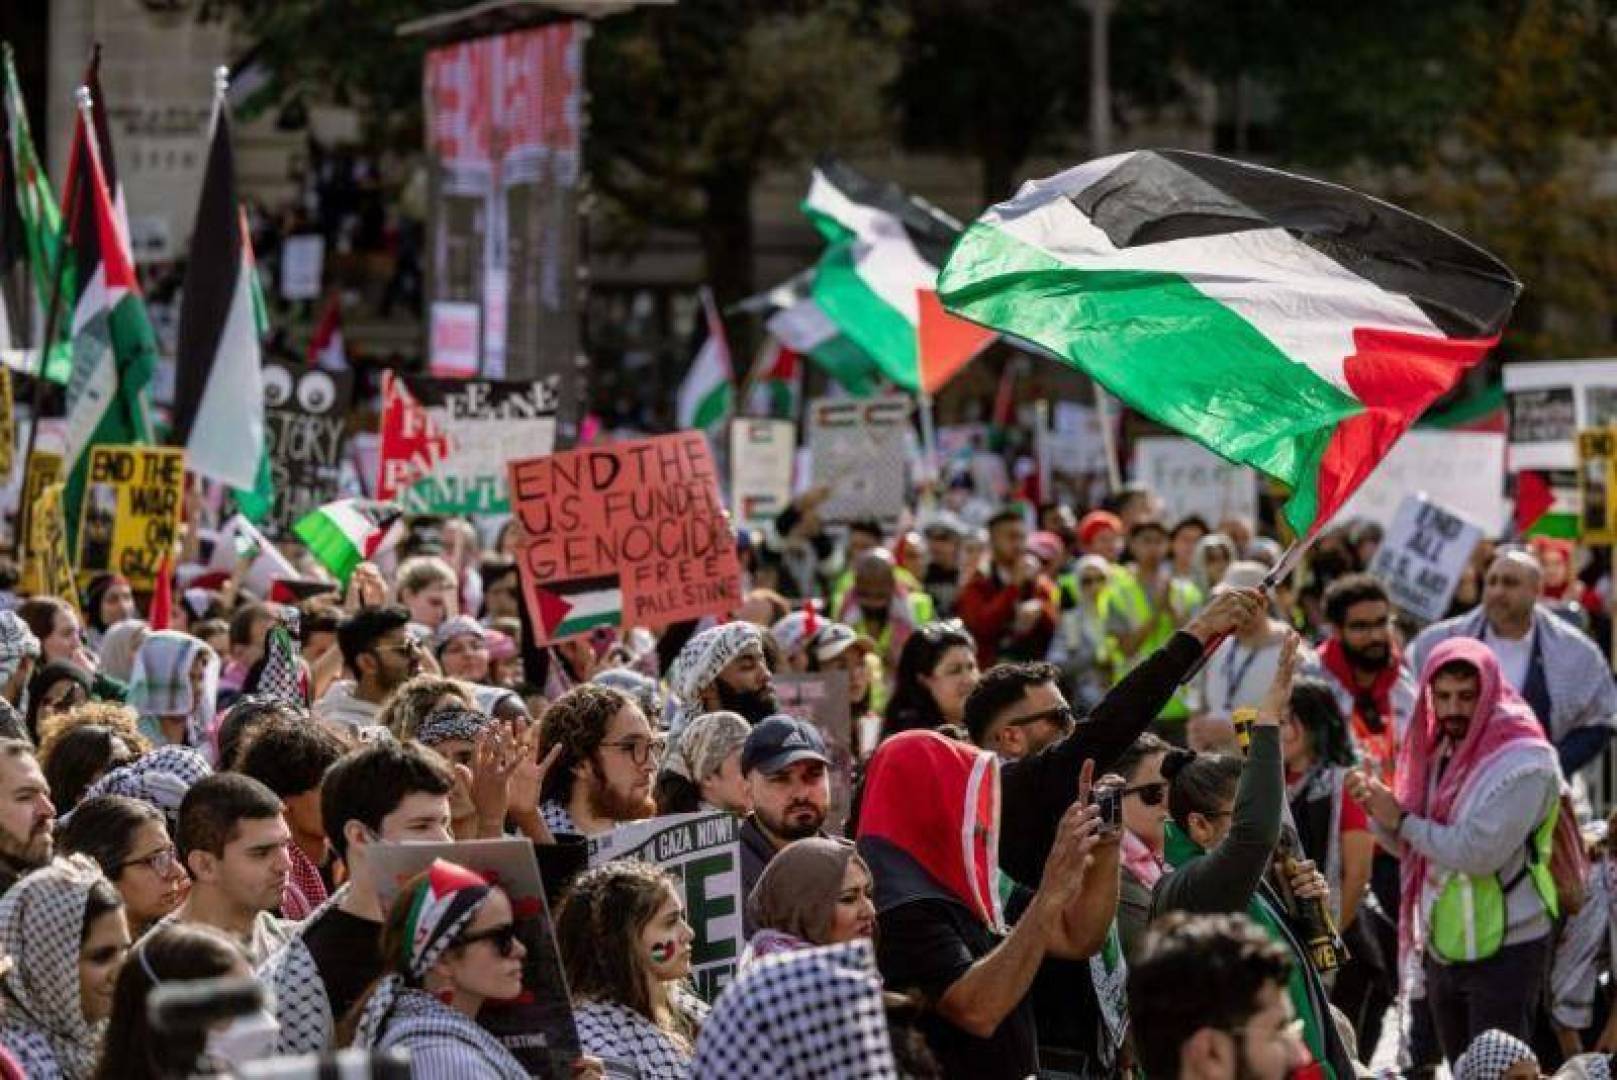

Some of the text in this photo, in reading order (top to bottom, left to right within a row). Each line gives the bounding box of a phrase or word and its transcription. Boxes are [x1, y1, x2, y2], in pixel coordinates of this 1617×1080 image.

[94, 451, 135, 482] END
[142, 452, 184, 486] THE
[514, 451, 622, 501] END
[628, 439, 713, 486] THE
[130, 485, 178, 517] WAR
[144, 516, 174, 547] ON
[526, 514, 732, 579] GENOCIDE
[635, 554, 718, 587] FREE
[635, 574, 740, 618] PALESTINE
[660, 825, 692, 859] GAZA
[696, 815, 733, 849] NOW!
